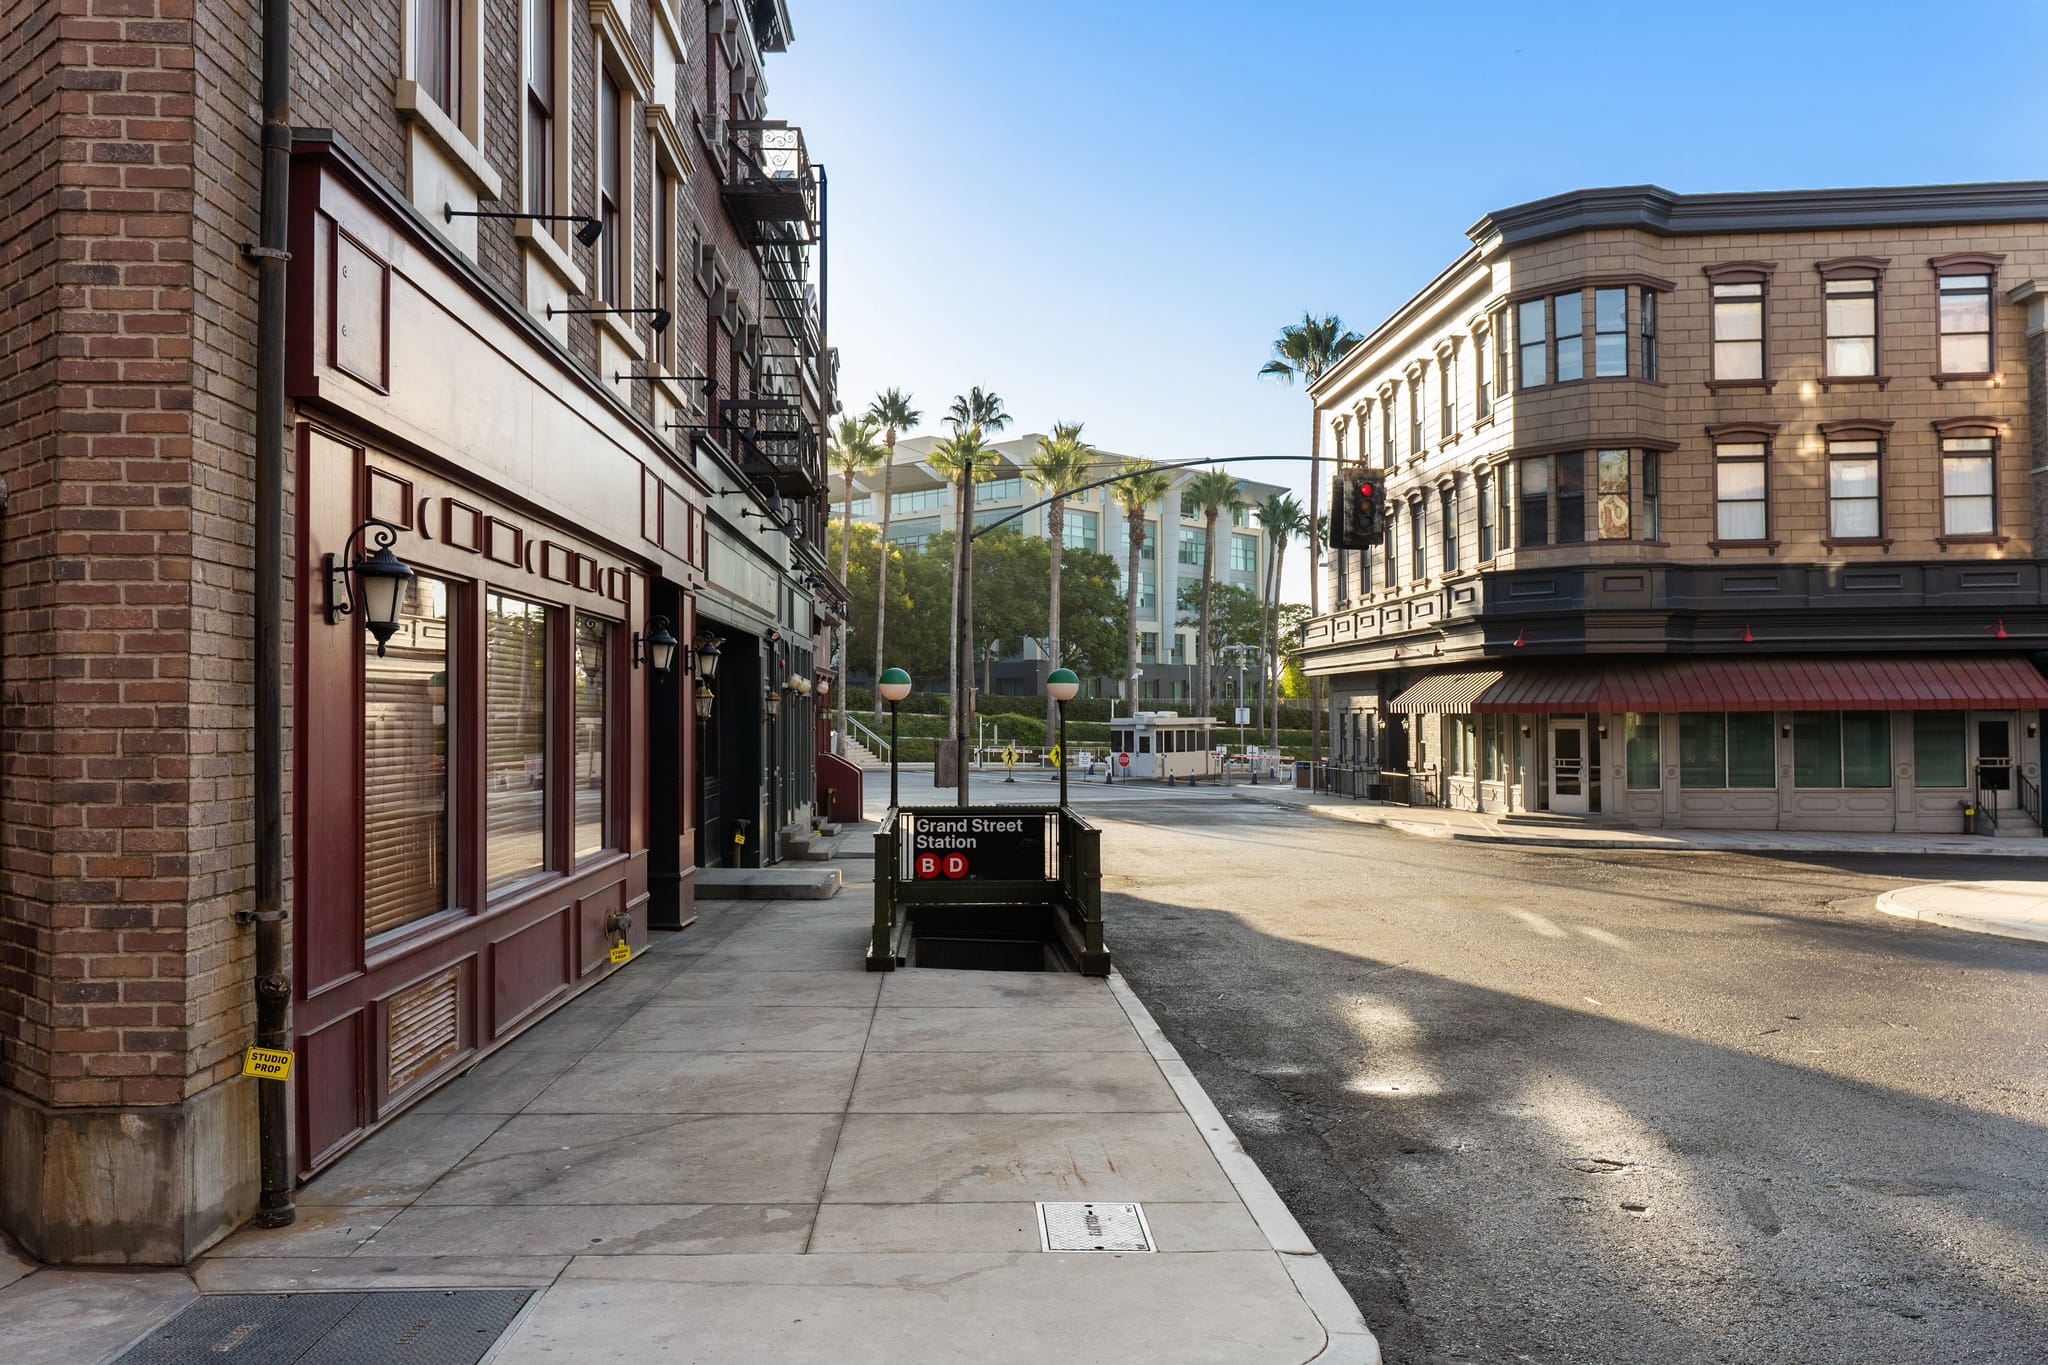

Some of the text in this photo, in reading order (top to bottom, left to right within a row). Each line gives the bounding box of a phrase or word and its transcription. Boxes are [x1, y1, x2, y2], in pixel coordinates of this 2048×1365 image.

[916, 818, 1023, 833] Grand Street
[916, 834, 977, 849] Station
[922, 858, 963, 873] B D
[251, 1052, 288, 1065] STUDIO
[254, 1063, 281, 1074] PROP
